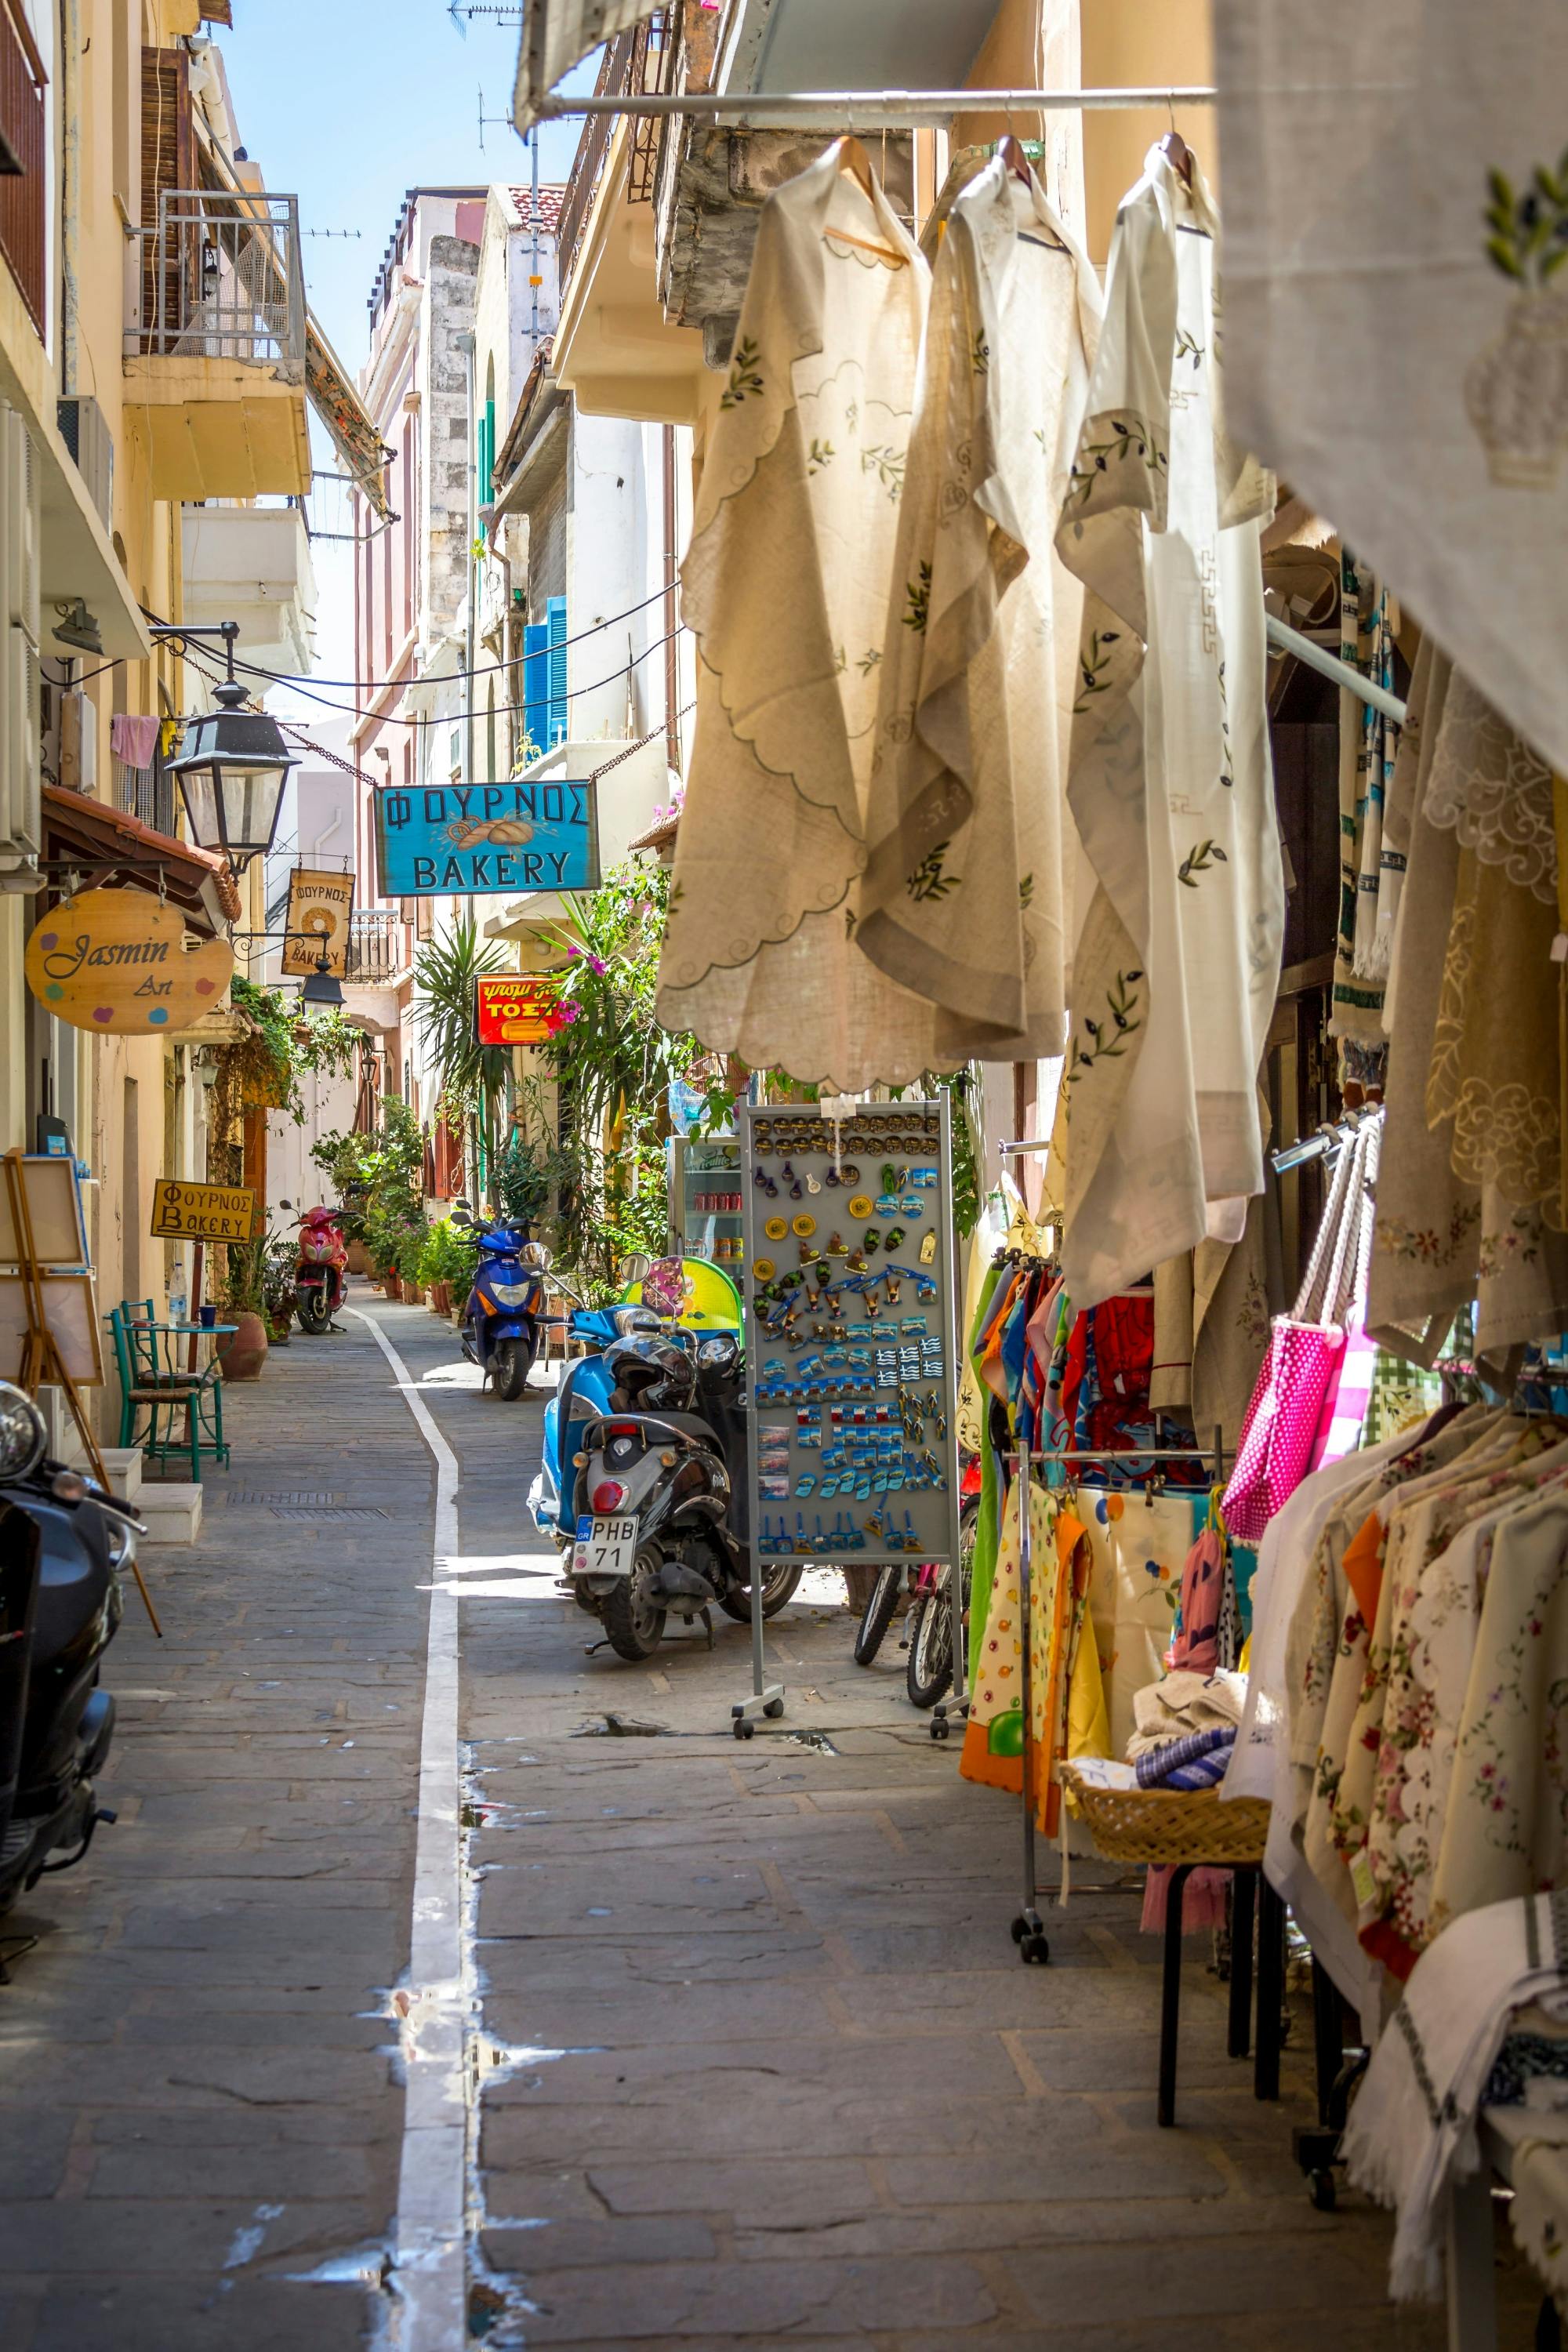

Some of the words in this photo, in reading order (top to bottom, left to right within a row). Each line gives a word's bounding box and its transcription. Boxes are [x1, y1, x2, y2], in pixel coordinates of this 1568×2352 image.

[387, 784, 590, 829] ΦΟΥΡΝΟΣ
[412, 852, 571, 888] BAKERY
[296, 886, 348, 903] ΦΟΥΡΝΟΣ
[44, 934, 169, 979] Jasmin
[133, 975, 174, 996] Art
[485, 1003, 557, 1017] ΤΟΣΤ
[163, 1182, 251, 1213] ΦΟΥΡΝΟΣ
[592, 1522, 634, 1541] PHB
[595, 1548, 621, 1567] 71
